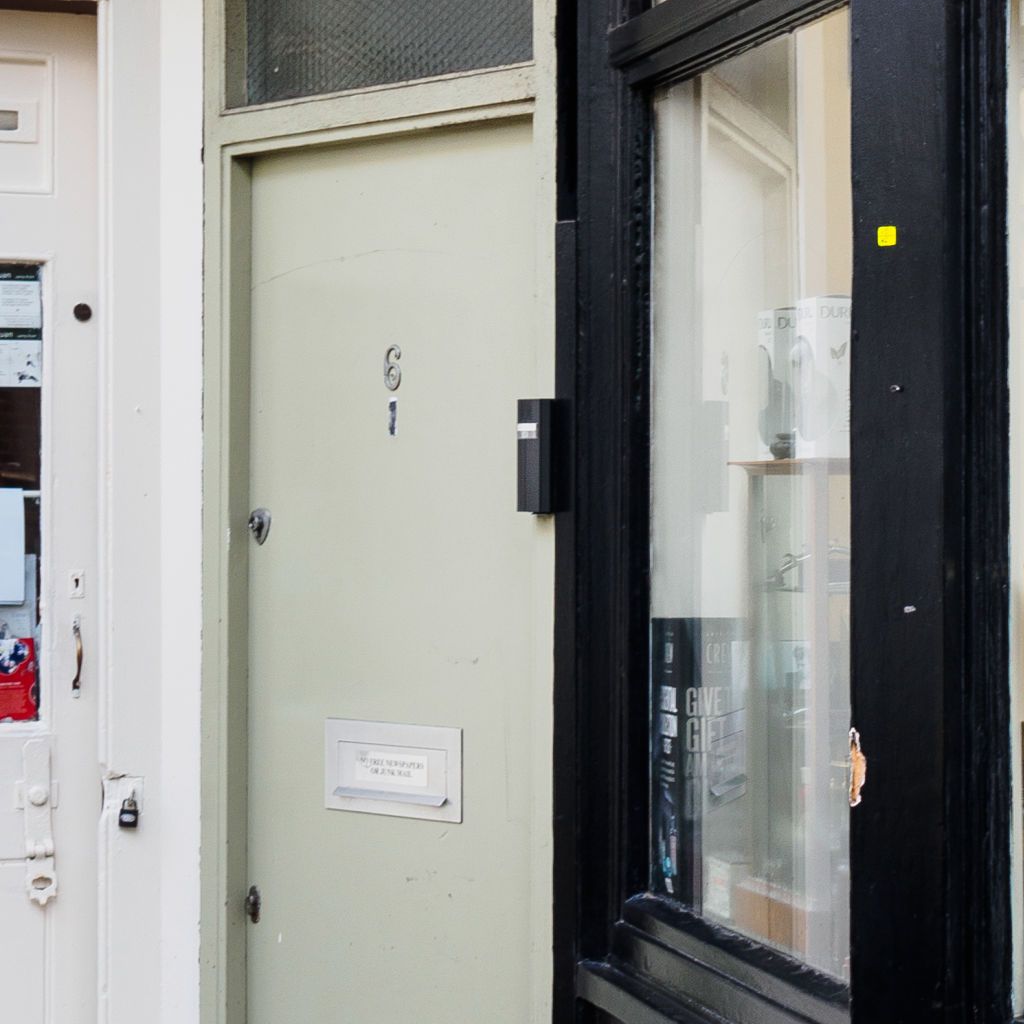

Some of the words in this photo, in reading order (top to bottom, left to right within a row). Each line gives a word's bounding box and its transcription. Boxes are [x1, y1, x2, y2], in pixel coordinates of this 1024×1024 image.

[820, 305, 849, 319] DUR
[383, 343, 402, 392] 6
[685, 686, 722, 717] GIVE
